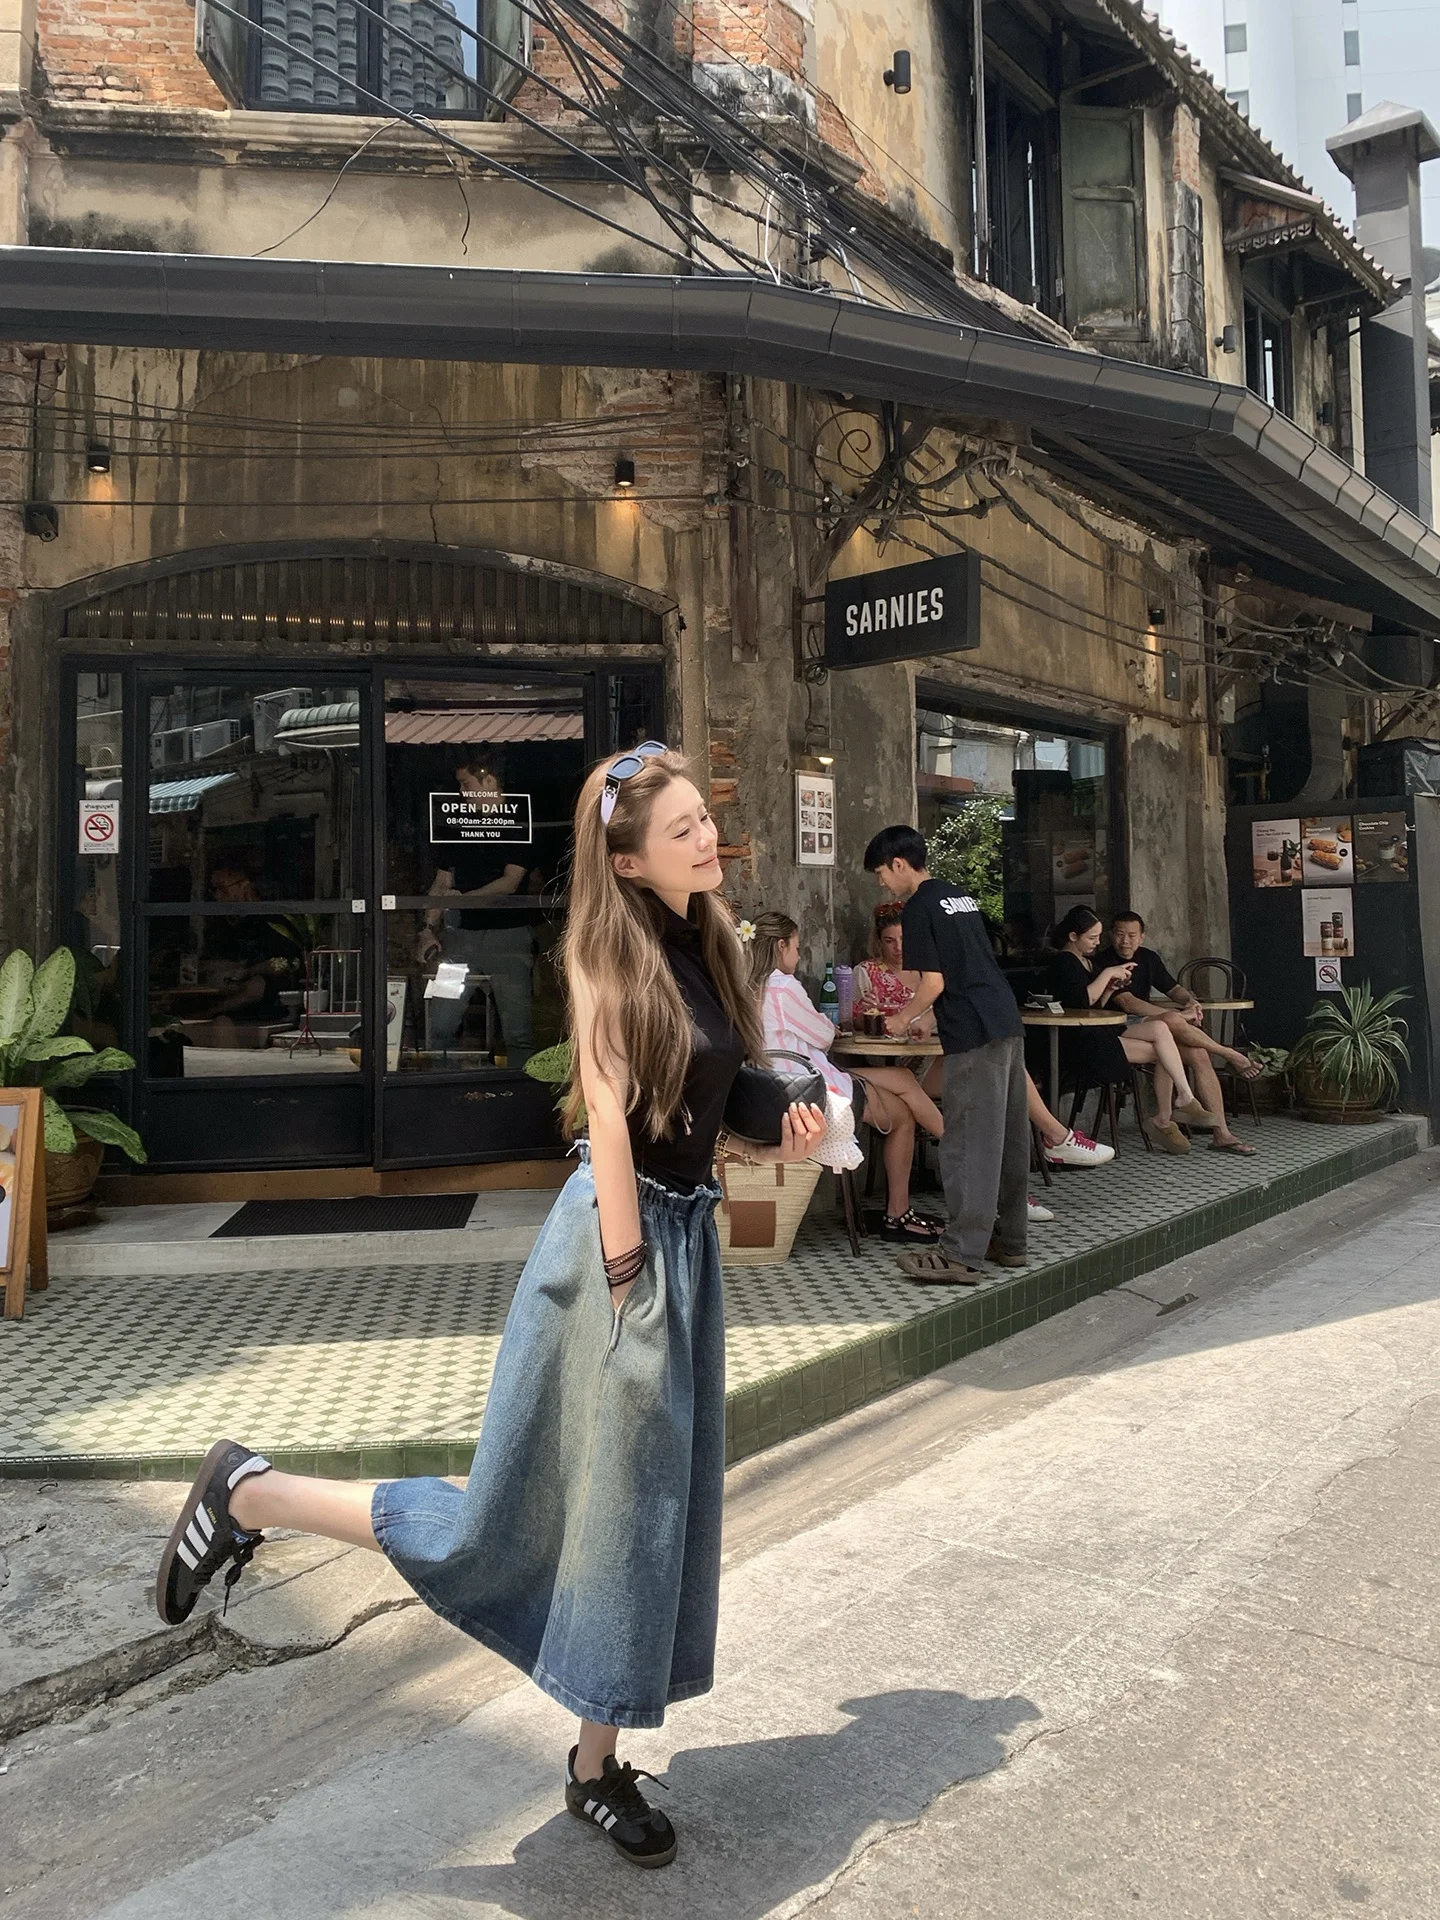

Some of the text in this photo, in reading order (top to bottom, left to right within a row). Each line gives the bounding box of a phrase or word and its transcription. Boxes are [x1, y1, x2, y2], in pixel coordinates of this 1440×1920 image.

[846, 587, 943, 636] SARNIES
[441, 803, 518, 813] OPEN DAILY
[446, 817, 515, 826] 08:00am-22:00pm
